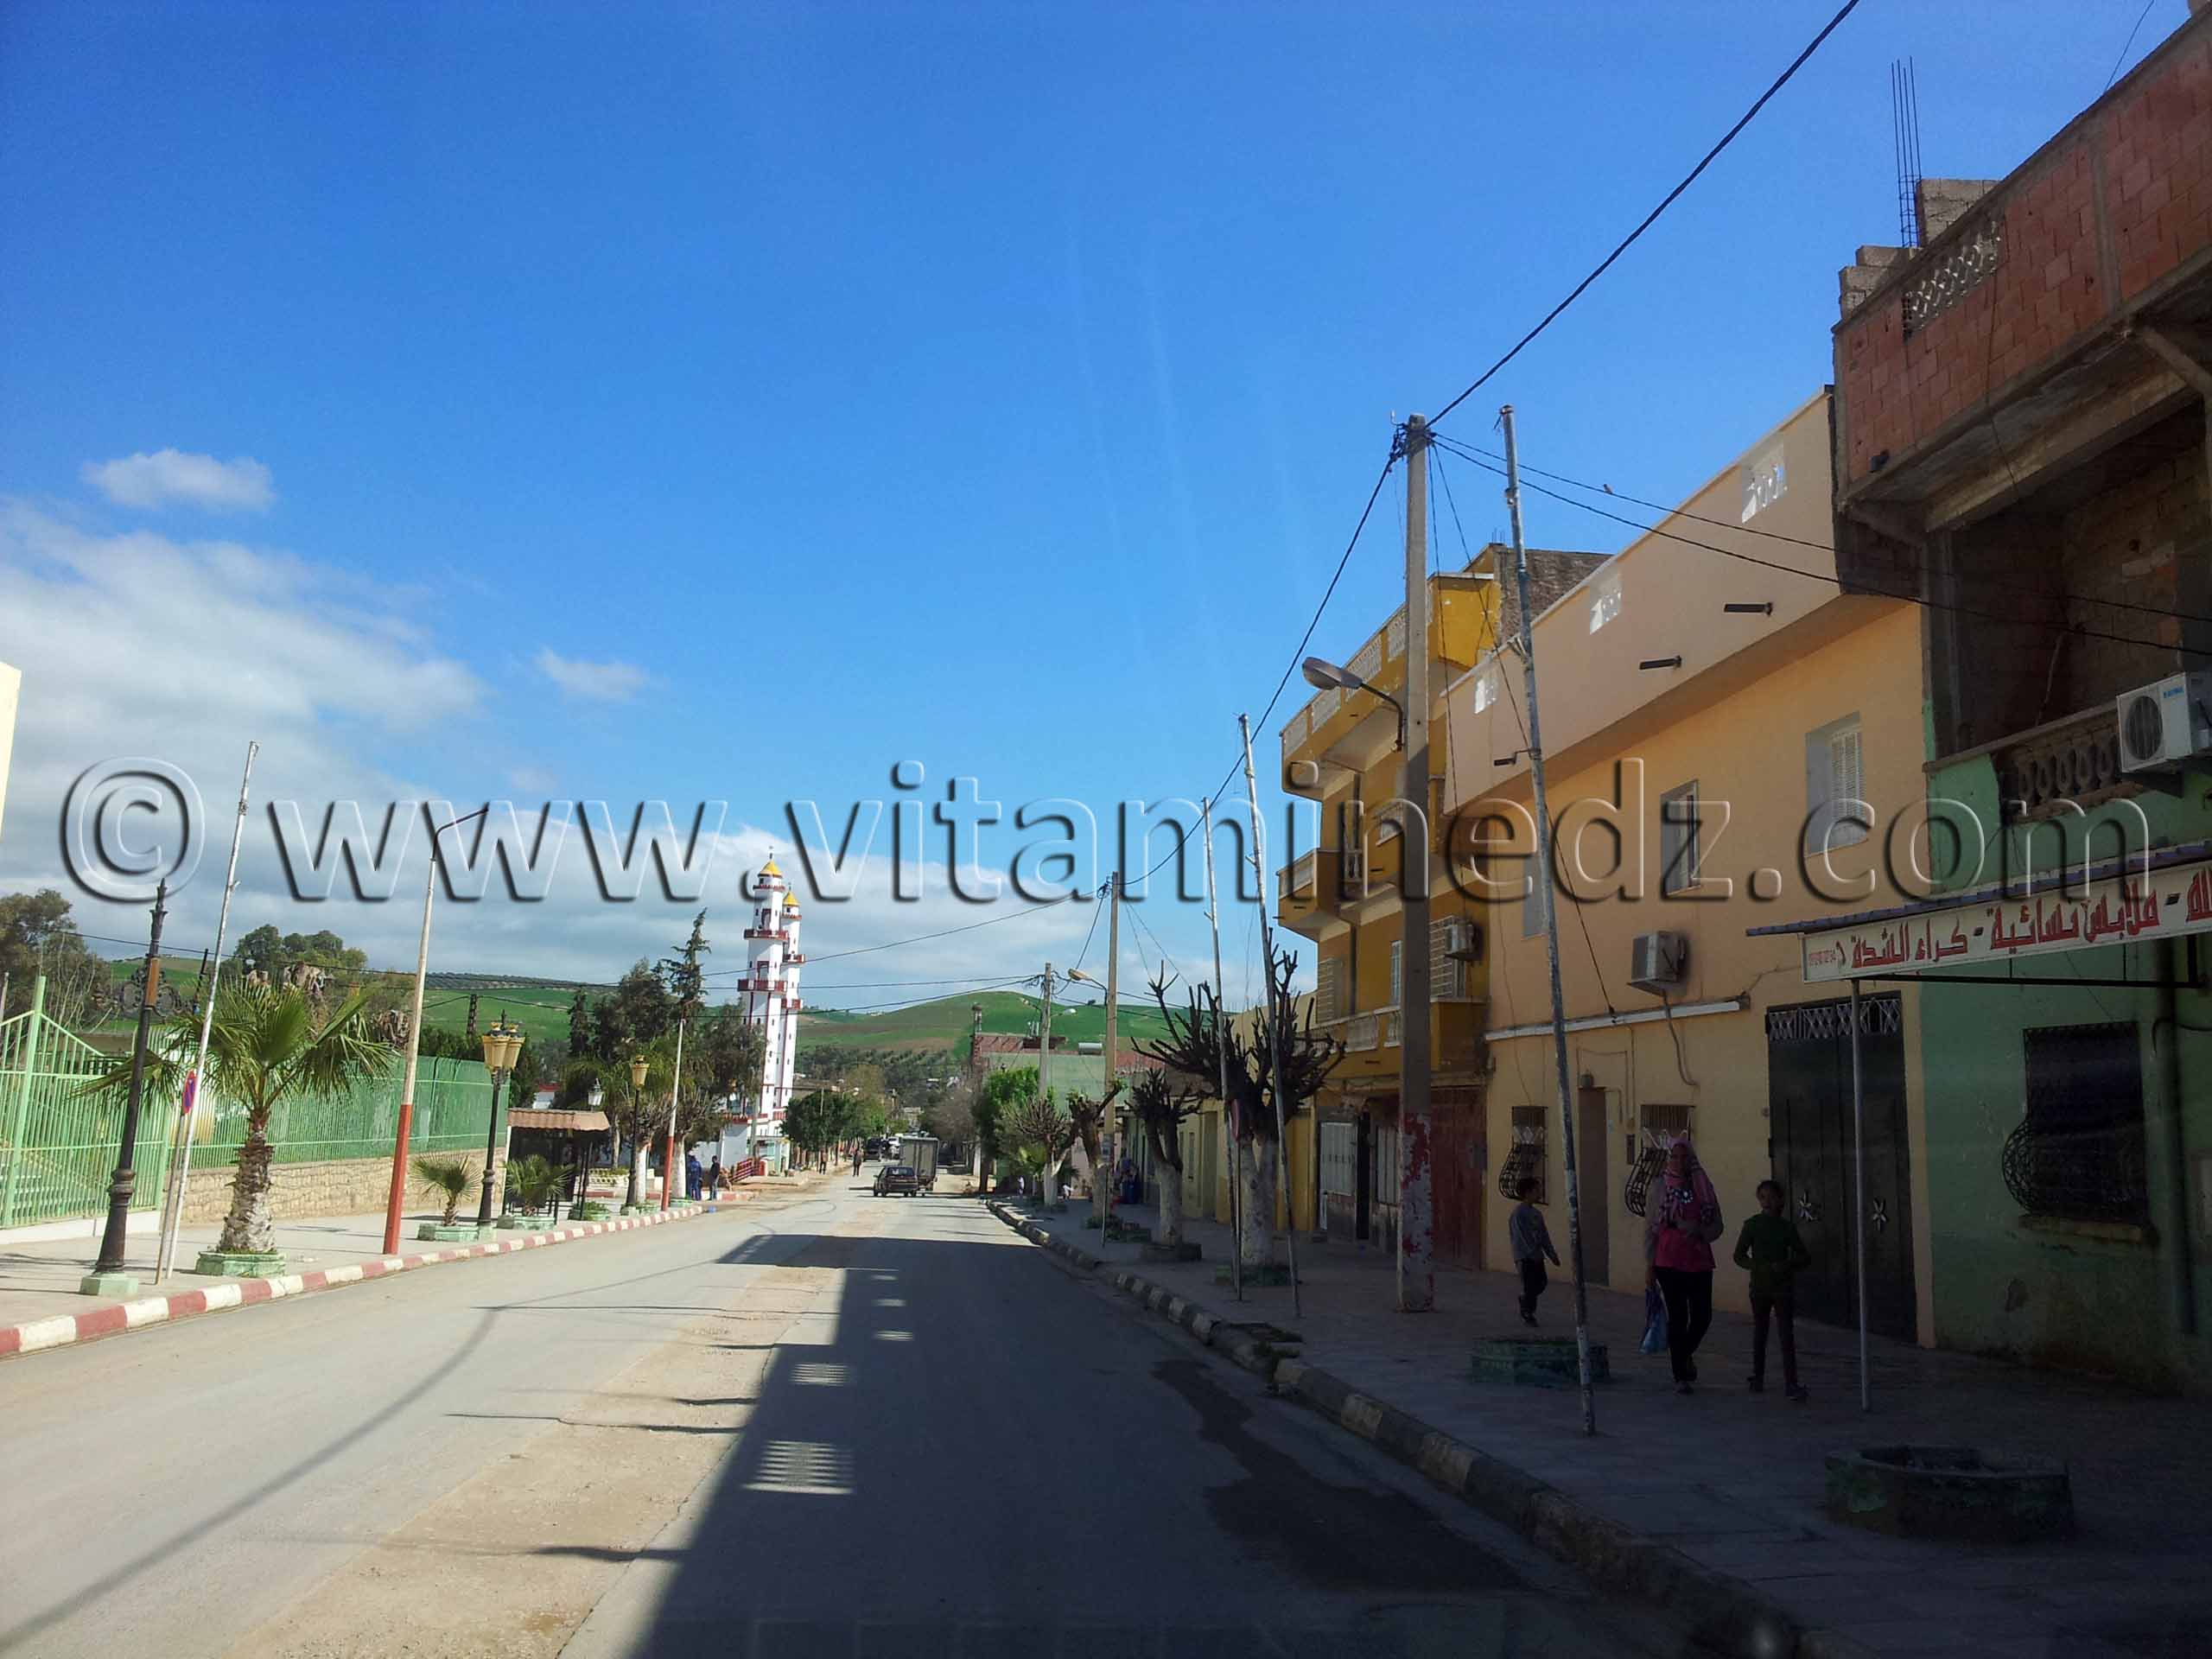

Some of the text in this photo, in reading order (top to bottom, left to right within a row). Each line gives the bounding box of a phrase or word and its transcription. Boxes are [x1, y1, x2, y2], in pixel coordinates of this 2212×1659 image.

[1986, 898, 2079, 955] نسائية
[2081, 879, 2160, 944] ملابس
[1915, 918, 1968, 963] كراء
